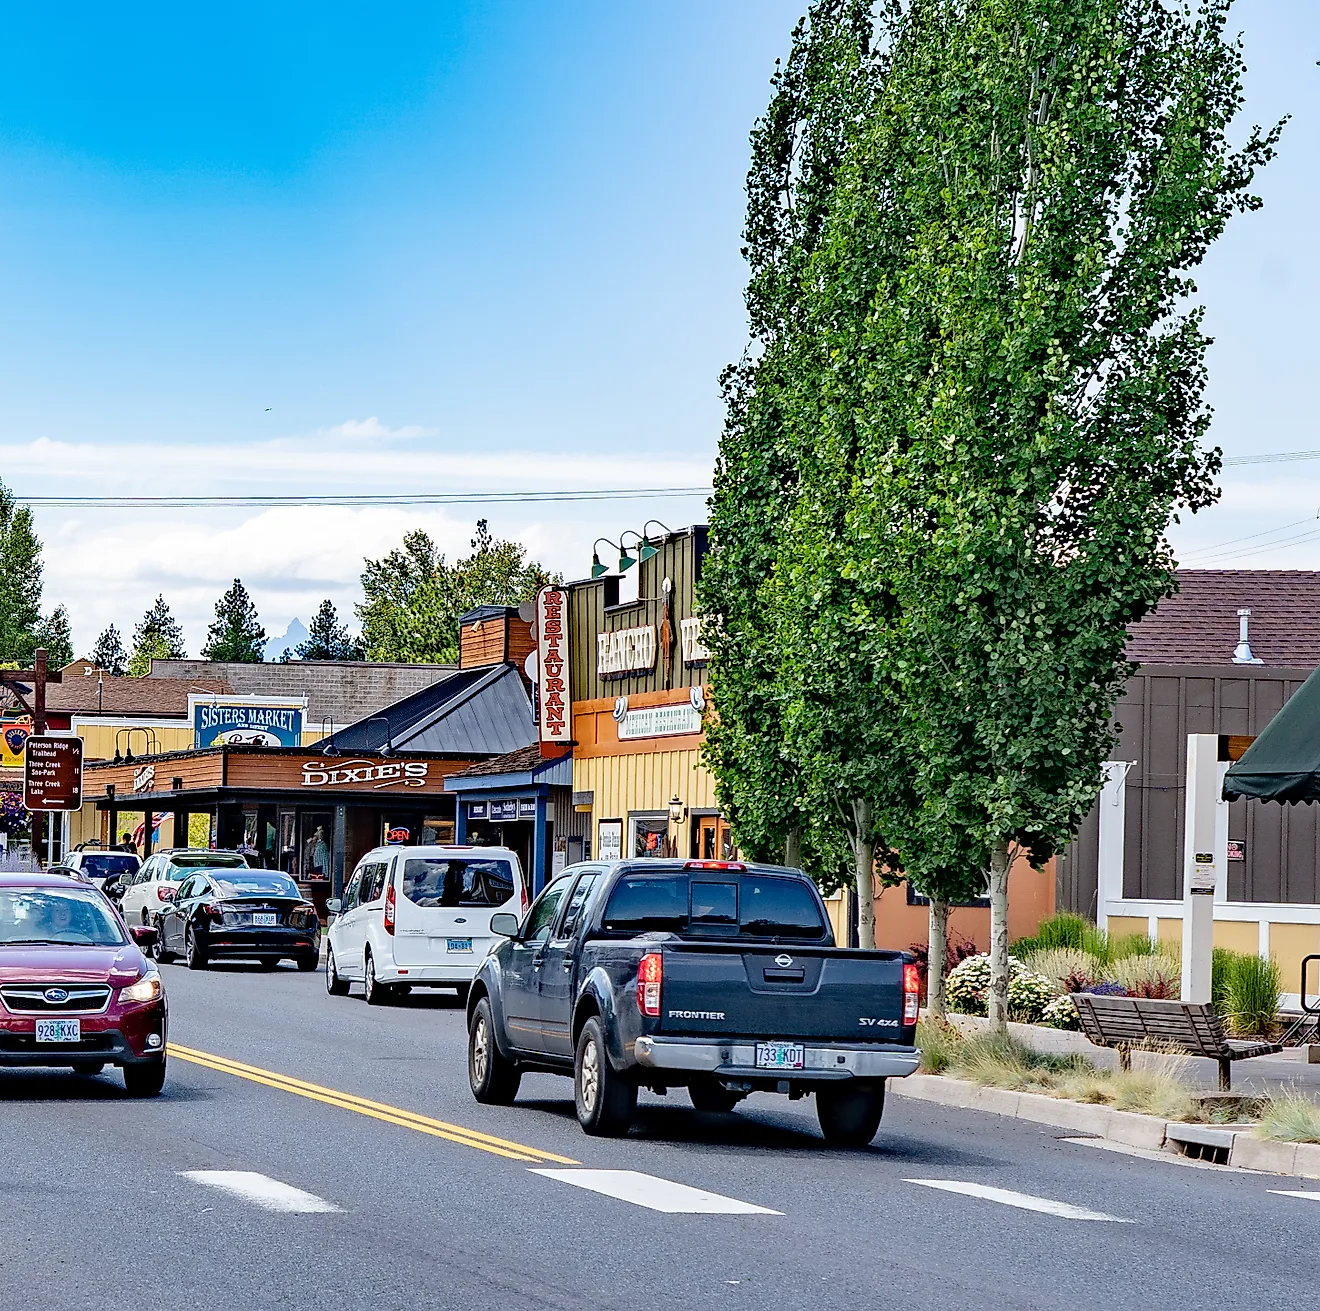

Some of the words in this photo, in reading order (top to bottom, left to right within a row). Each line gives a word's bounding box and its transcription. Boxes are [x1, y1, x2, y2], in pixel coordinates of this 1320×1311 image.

[598, 625, 656, 674] RANCHO
[543, 591, 565, 736] RESTAURANT
[201, 707, 247, 730] SISTERS
[248, 708, 295, 733] MARKET
[28, 741, 52, 749] Peterson
[53, 742, 69, 751] Ridge
[28, 760, 44, 768] Three
[300, 761, 428, 786] DIXIE'S
[44, 780, 61, 788] Creek
[386, 830, 409, 841] OPEN
[668, 1010, 725, 1020] FRONTIER
[858, 1018, 876, 1026] SV
[38, 1025, 55, 1037] 928
[60, 1025, 78, 1037] KXC
[758, 1048, 777, 1062] 733
[783, 1049, 802, 1063] KDT
